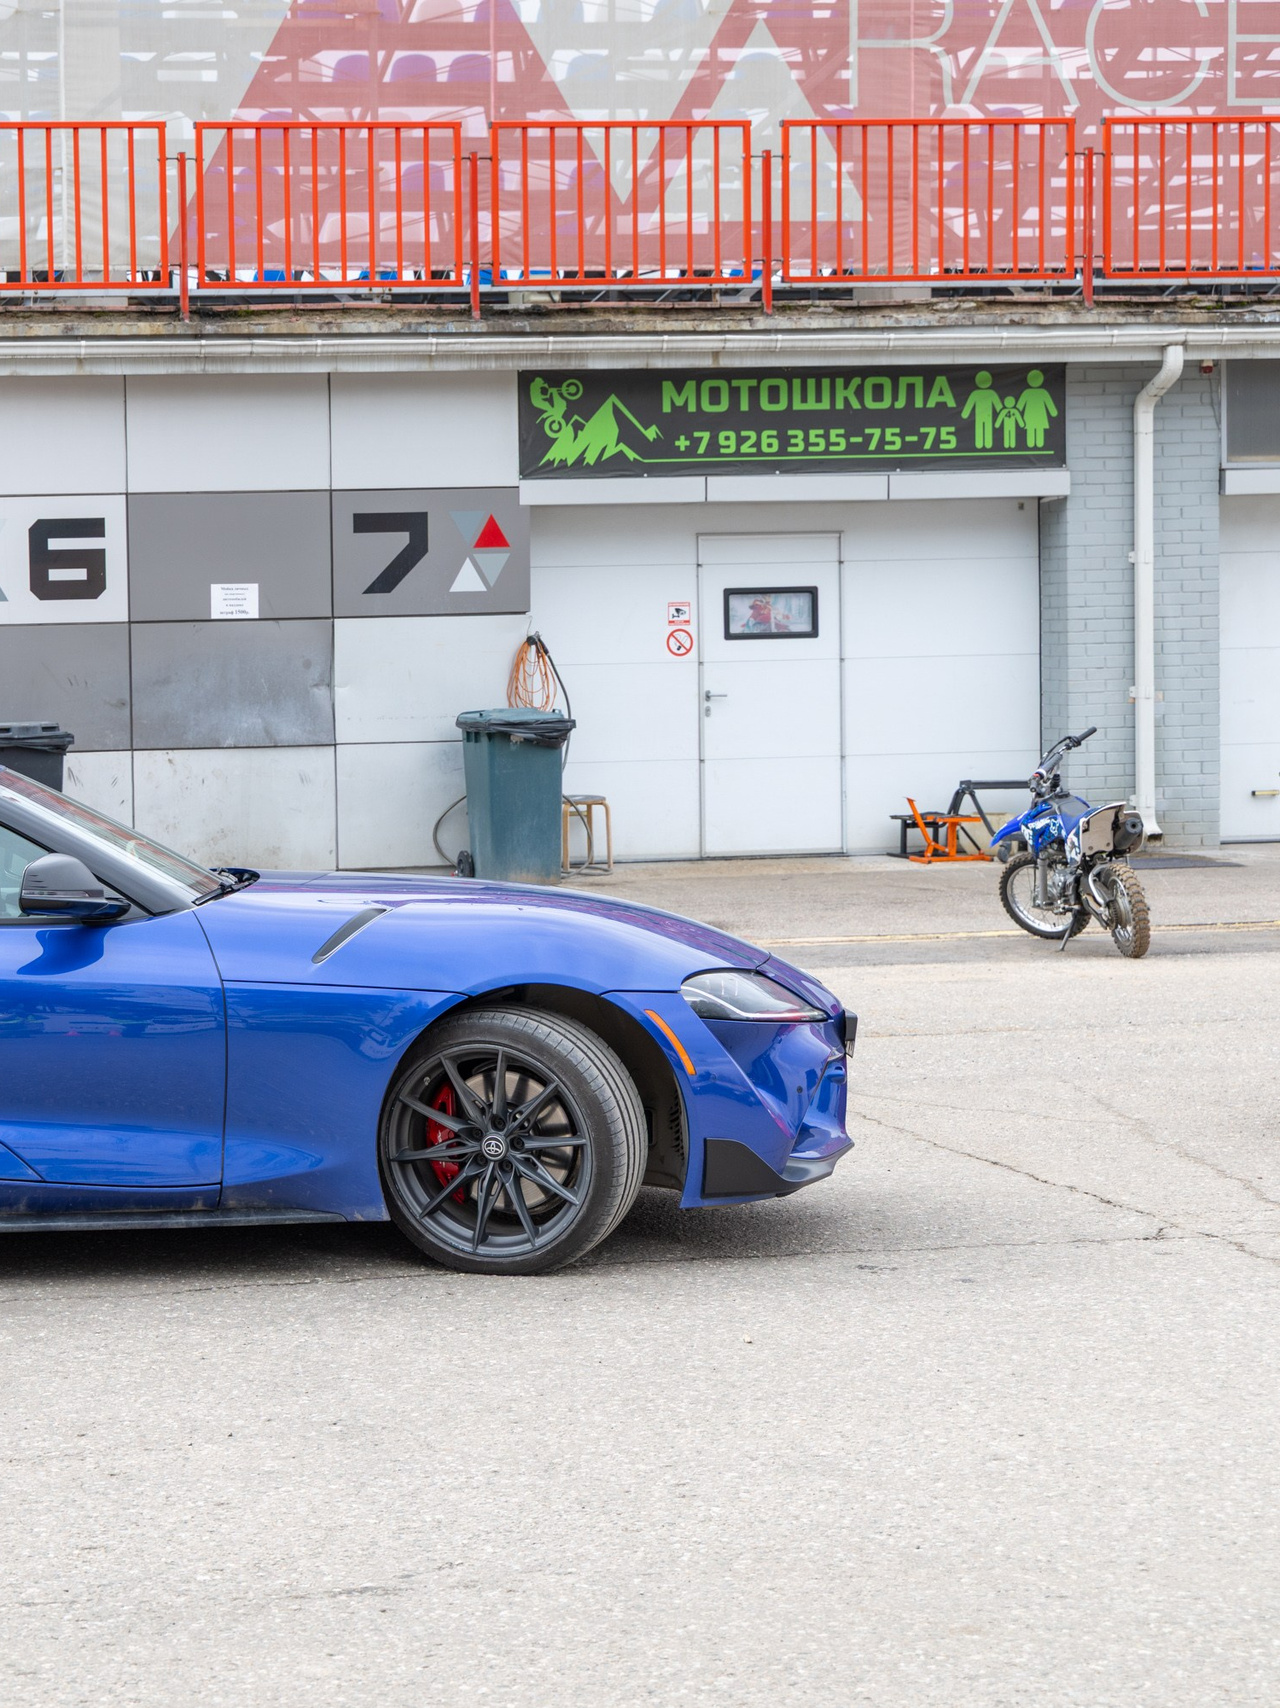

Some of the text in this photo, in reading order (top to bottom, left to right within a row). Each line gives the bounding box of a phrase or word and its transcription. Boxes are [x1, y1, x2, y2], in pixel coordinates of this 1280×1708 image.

[662, 376, 957, 413] МОТОШКОЛА
[674, 426, 957, 454] +7 926 355-75-75
[28, 517, 107, 601] 6
[353, 511, 429, 595] 7
